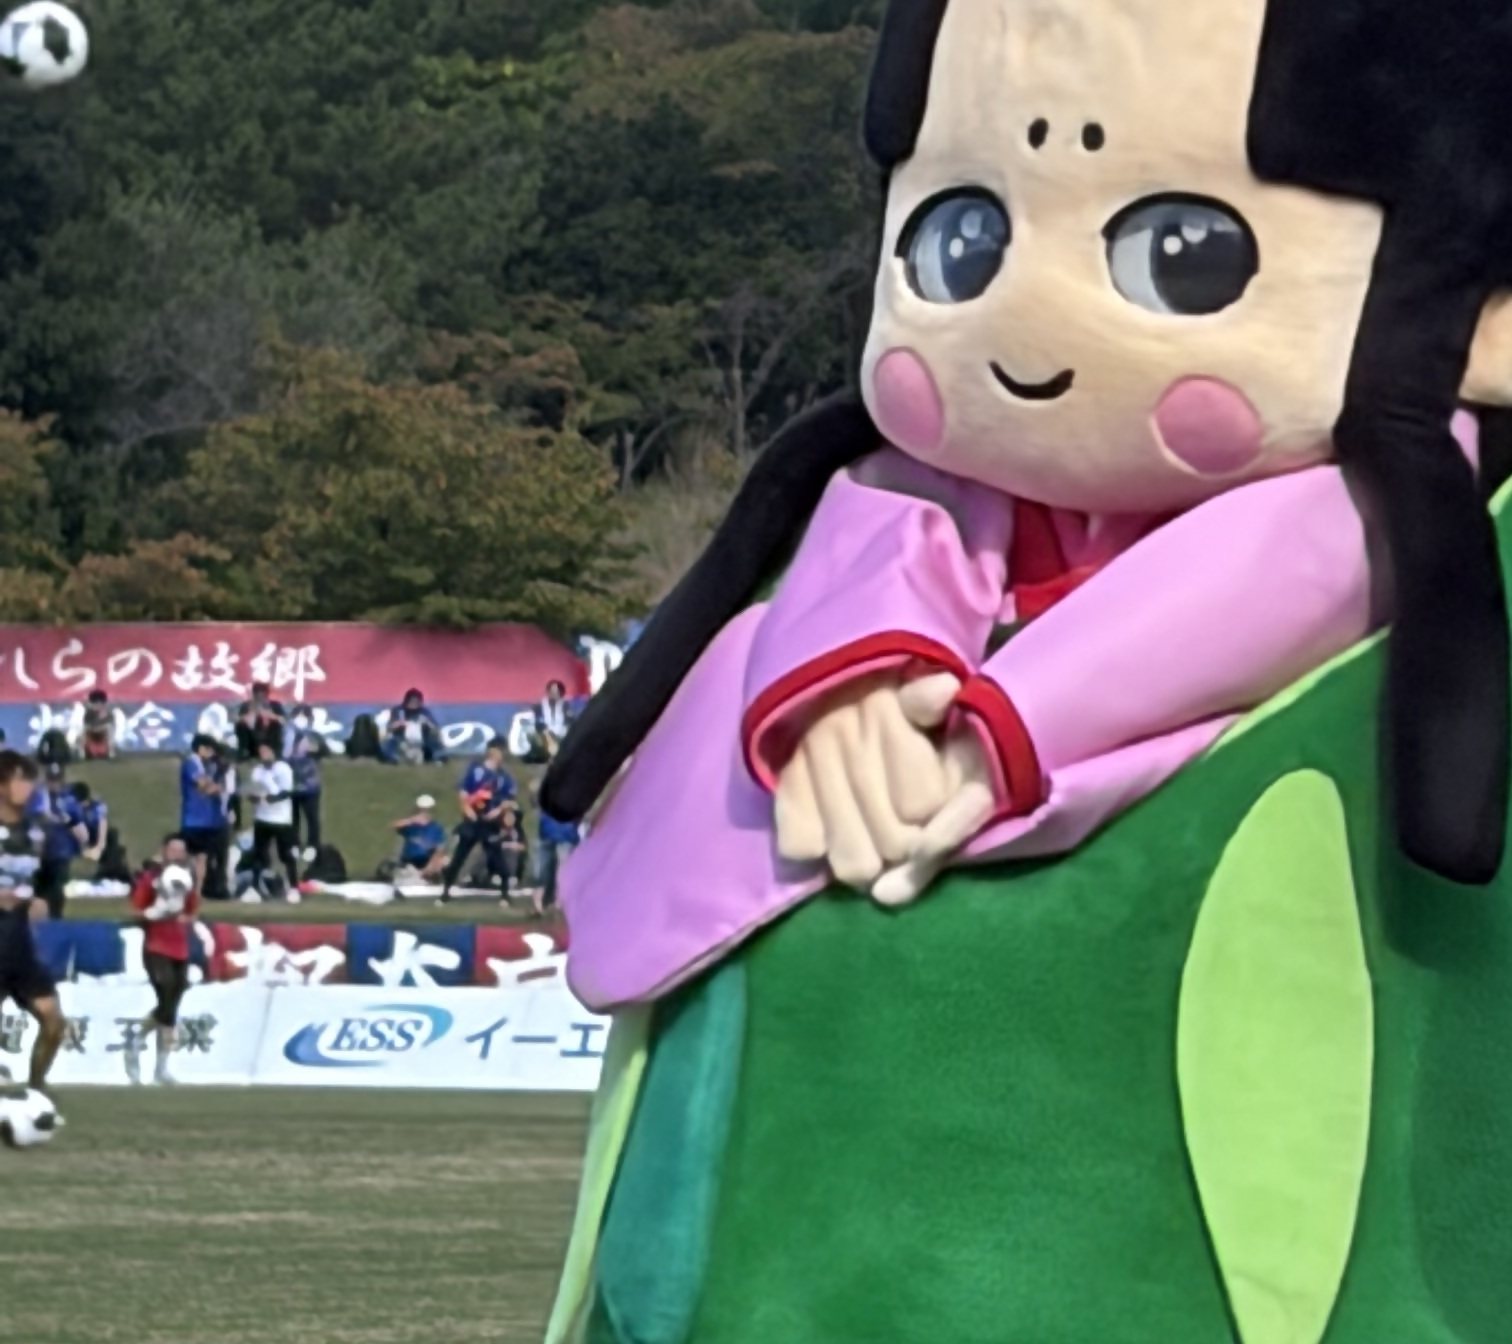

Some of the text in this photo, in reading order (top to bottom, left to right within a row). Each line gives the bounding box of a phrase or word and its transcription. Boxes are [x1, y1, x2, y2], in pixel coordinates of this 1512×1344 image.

[0, 638, 326, 702] しらの故郷
[327, 1018, 423, 1052] ESS
